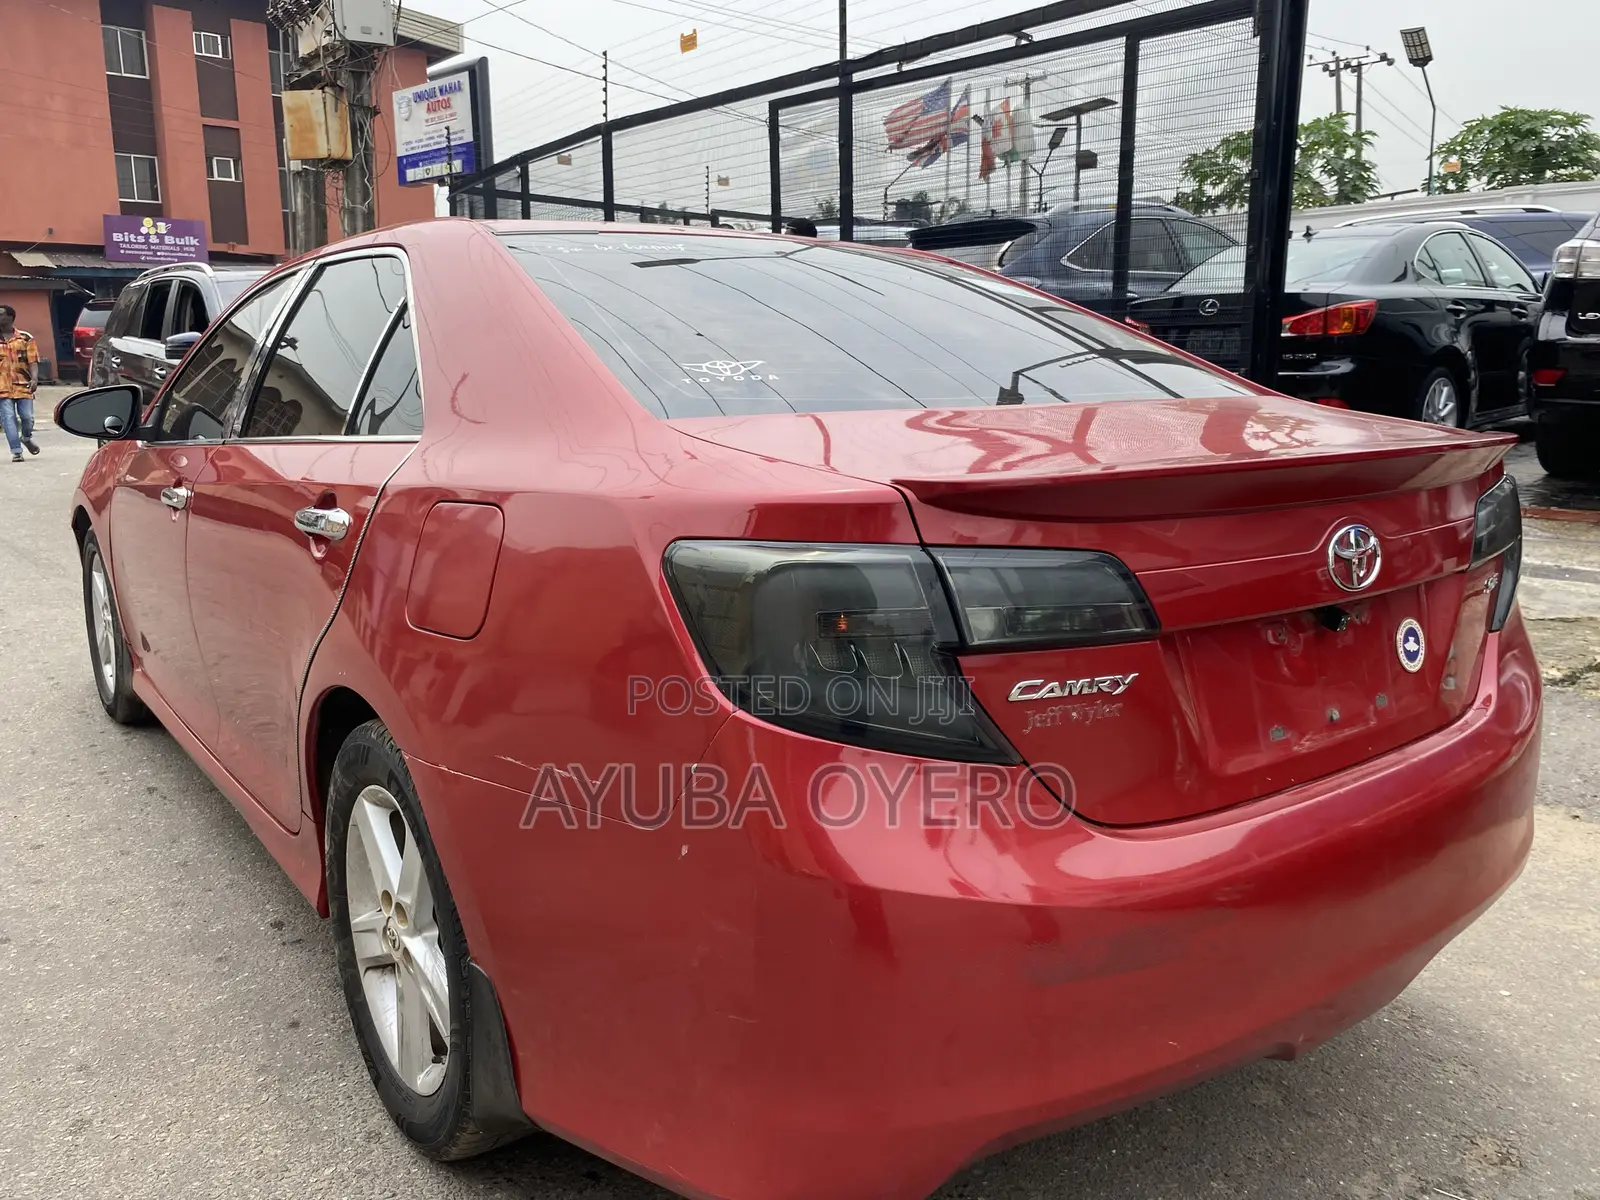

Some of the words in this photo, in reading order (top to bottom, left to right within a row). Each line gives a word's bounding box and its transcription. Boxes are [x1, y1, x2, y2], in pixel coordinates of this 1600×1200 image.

[412, 87, 437, 103] UNIQUE
[426, 97, 451, 113] AUTOS
[112, 232, 145, 243] Bits
[148, 234, 160, 244] &
[164, 235, 200, 246] Bulk
[1007, 672, 1140, 702] CAMRY
[1022, 704, 1065, 735] Jeff
[1065, 700, 1124, 726] Wyler
